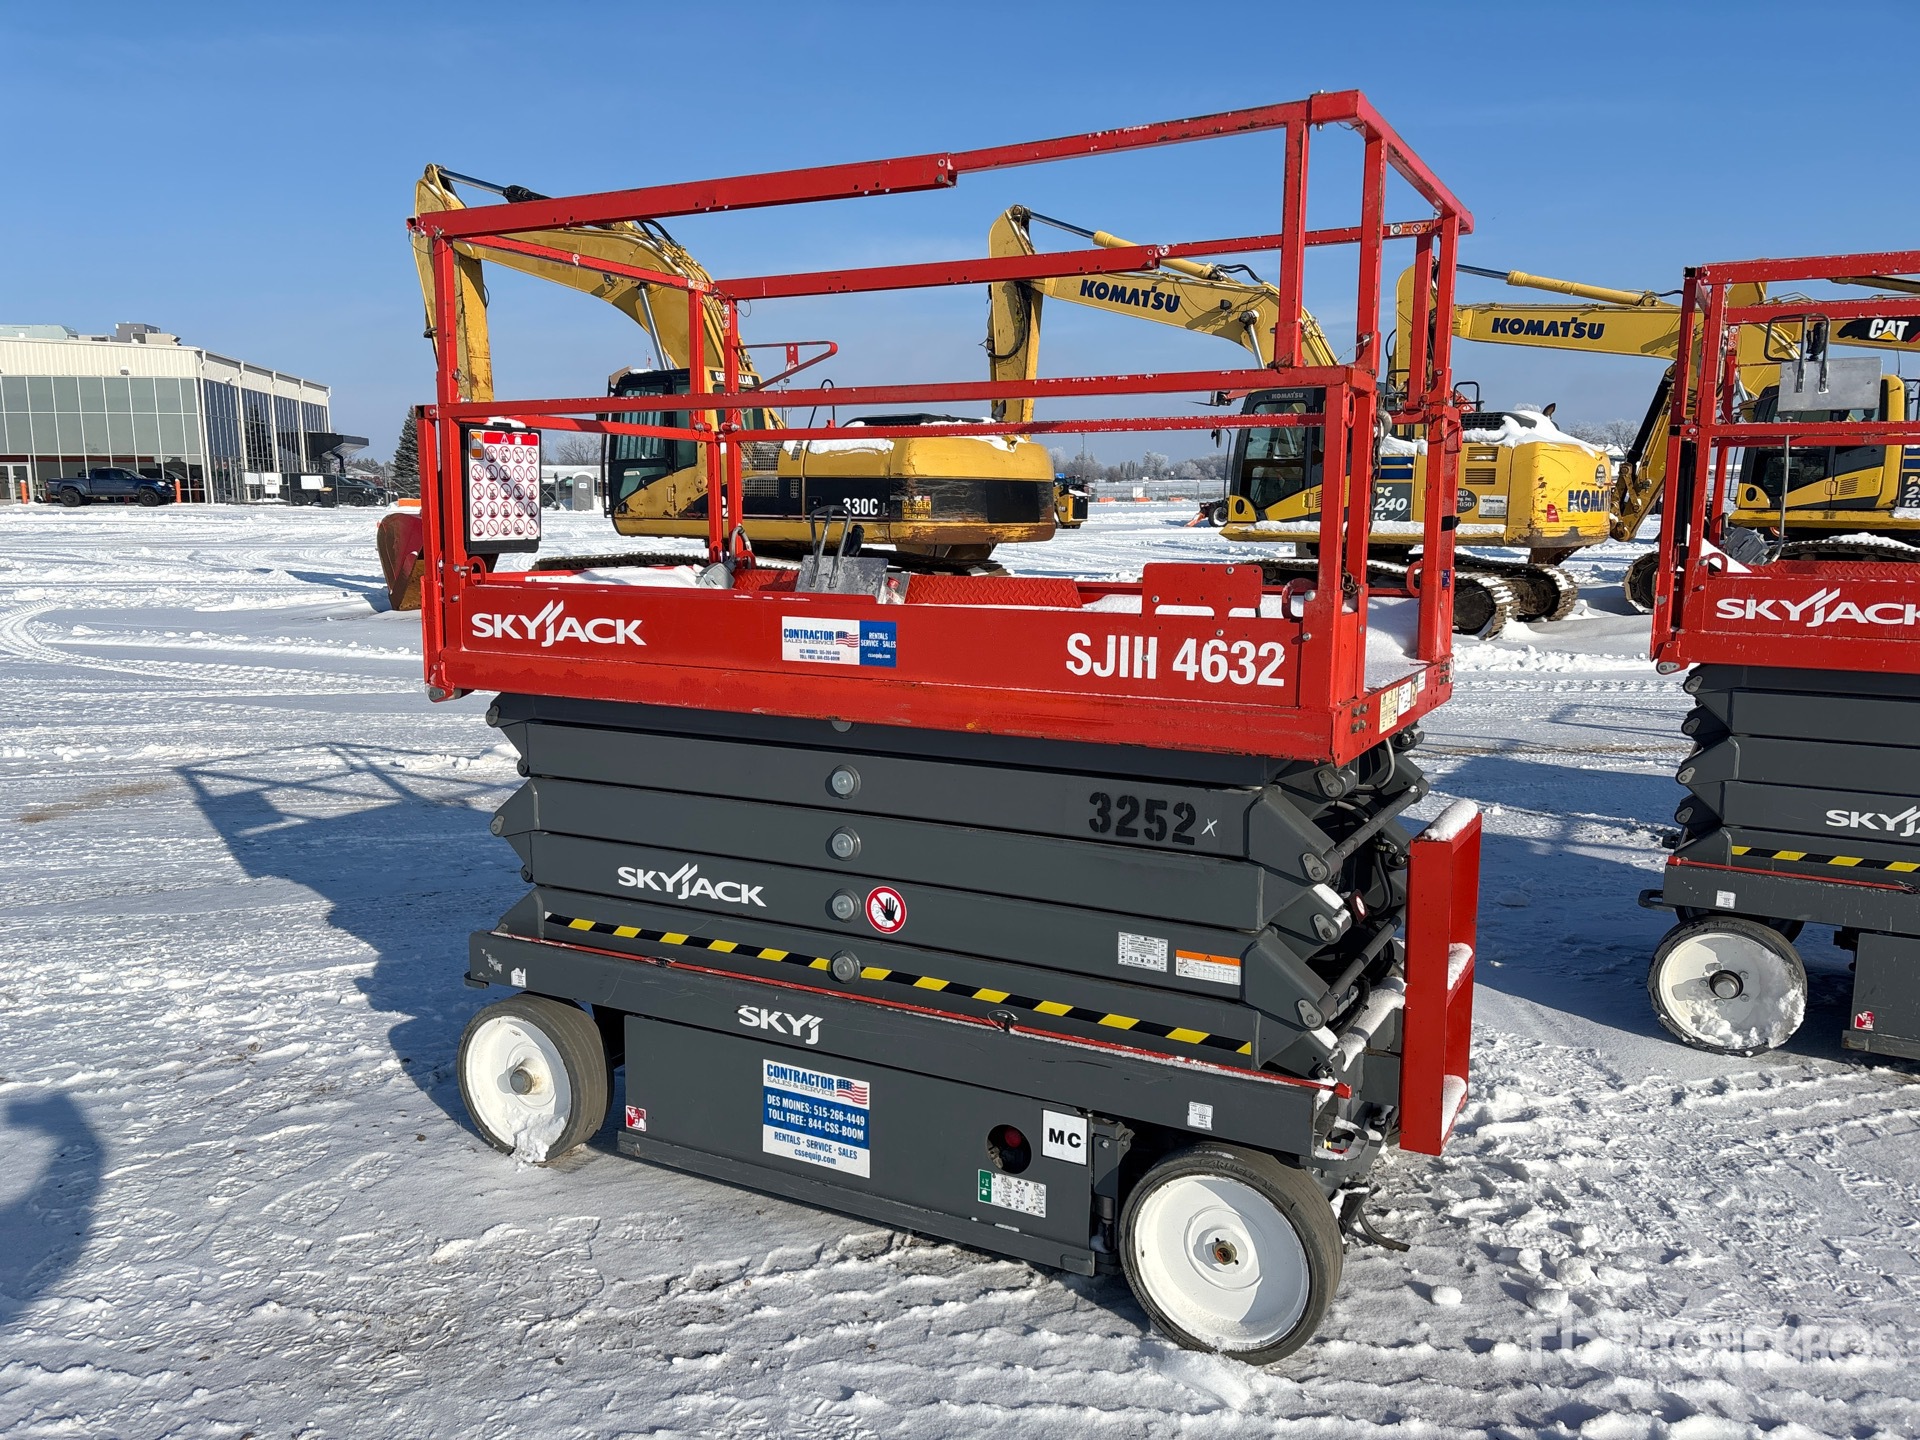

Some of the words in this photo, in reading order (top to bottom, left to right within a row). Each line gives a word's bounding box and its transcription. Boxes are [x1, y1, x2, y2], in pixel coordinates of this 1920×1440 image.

[1080, 279, 1180, 313] KOMATSU
[1491, 317, 1605, 339] KOMATSU
[1869, 319, 1909, 340] CAT
[1271, 391, 1304, 399] KOMATSU
[1904, 486, 1920, 499] 2
[842, 497, 878, 515] 330C
[1374, 498, 1407, 511] 240
[1374, 512, 1387, 521] LC
[471, 599, 647, 648] SKYJACK
[783, 628, 835, 641] CONTRACTOR
[860, 640, 879, 648] SERVICE
[882, 640, 897, 648] SALES
[868, 632, 889, 640] RENTALS
[1065, 632, 1158, 680] SJIII
[1172, 637, 1285, 687] 4632
[1089, 792, 1196, 846] 3252
[1825, 805, 1920, 837] SKYJ
[617, 862, 767, 908] SKYJACK
[737, 1004, 823, 1045] SKYJ
[766, 1063, 835, 1091] CONTRACTOR
[766, 1076, 792, 1088] SALES
[799, 1084, 836, 1098] SERVICE
[767, 1094, 781, 1107] DES
[782, 1097, 812, 1114] MOINES:
[813, 1106, 865, 1127] 515-266-4449
[768, 1108, 785, 1121] TOLL
[786, 1112, 807, 1127] FREE:
[808, 1117, 864, 1141] 844-CSS-BOOM
[774, 1131, 801, 1146] RENTALS
[806, 1139, 833, 1154] SERVICE
[837, 1147, 858, 1160] SALES
[1048, 1127, 1082, 1149] MC
[794, 1147, 837, 1165] cssequip.com
